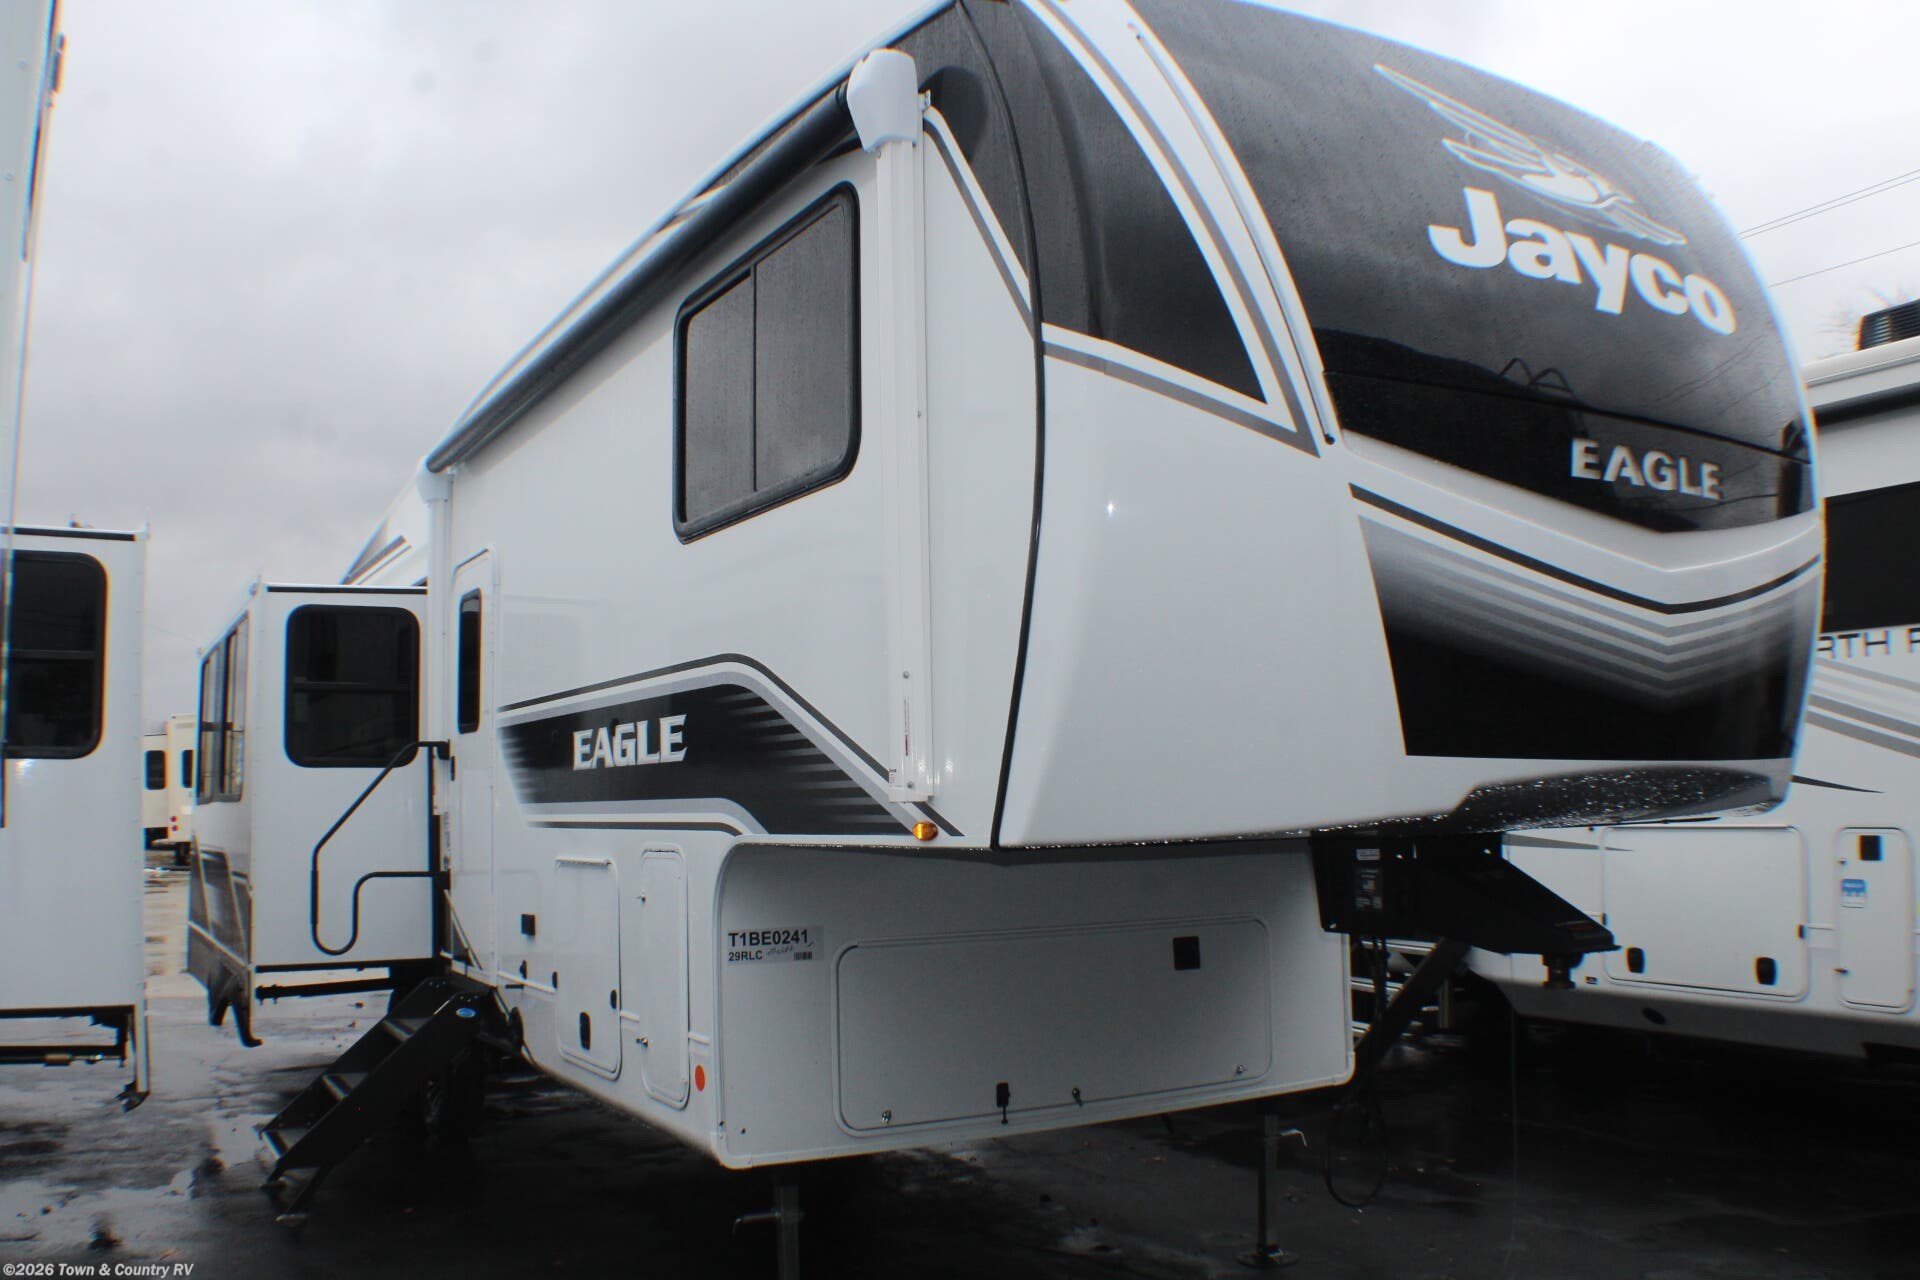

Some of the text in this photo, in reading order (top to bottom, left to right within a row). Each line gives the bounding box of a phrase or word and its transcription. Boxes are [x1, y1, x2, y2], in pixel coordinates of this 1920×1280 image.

[1428, 187, 1737, 335] Jayco
[1571, 438, 1721, 500] EAGLE
[573, 714, 688, 770] EAGLE
[728, 929, 808, 947] T1BE0241
[728, 950, 763, 961] 29RLC
